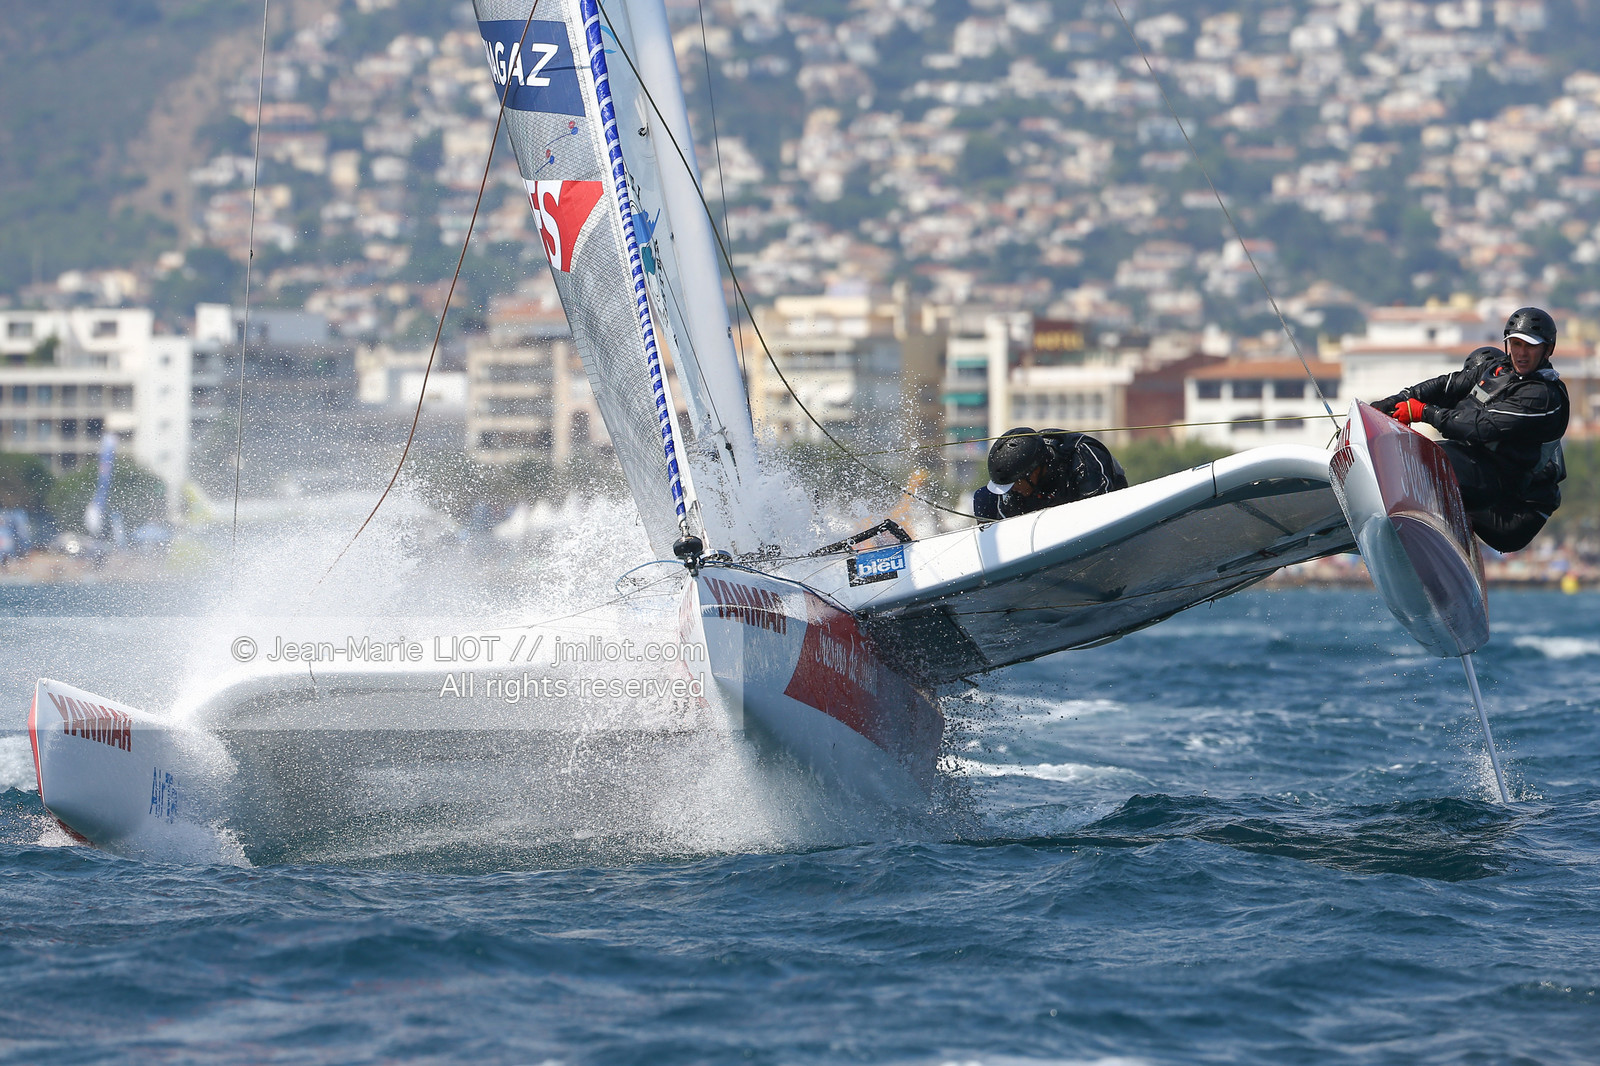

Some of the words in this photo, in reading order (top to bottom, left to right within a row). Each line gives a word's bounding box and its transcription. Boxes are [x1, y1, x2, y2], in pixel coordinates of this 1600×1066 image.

[858, 558, 904, 577] bleu
[703, 576, 787, 636] YANMAR
[48, 692, 132, 752] YANMAR
